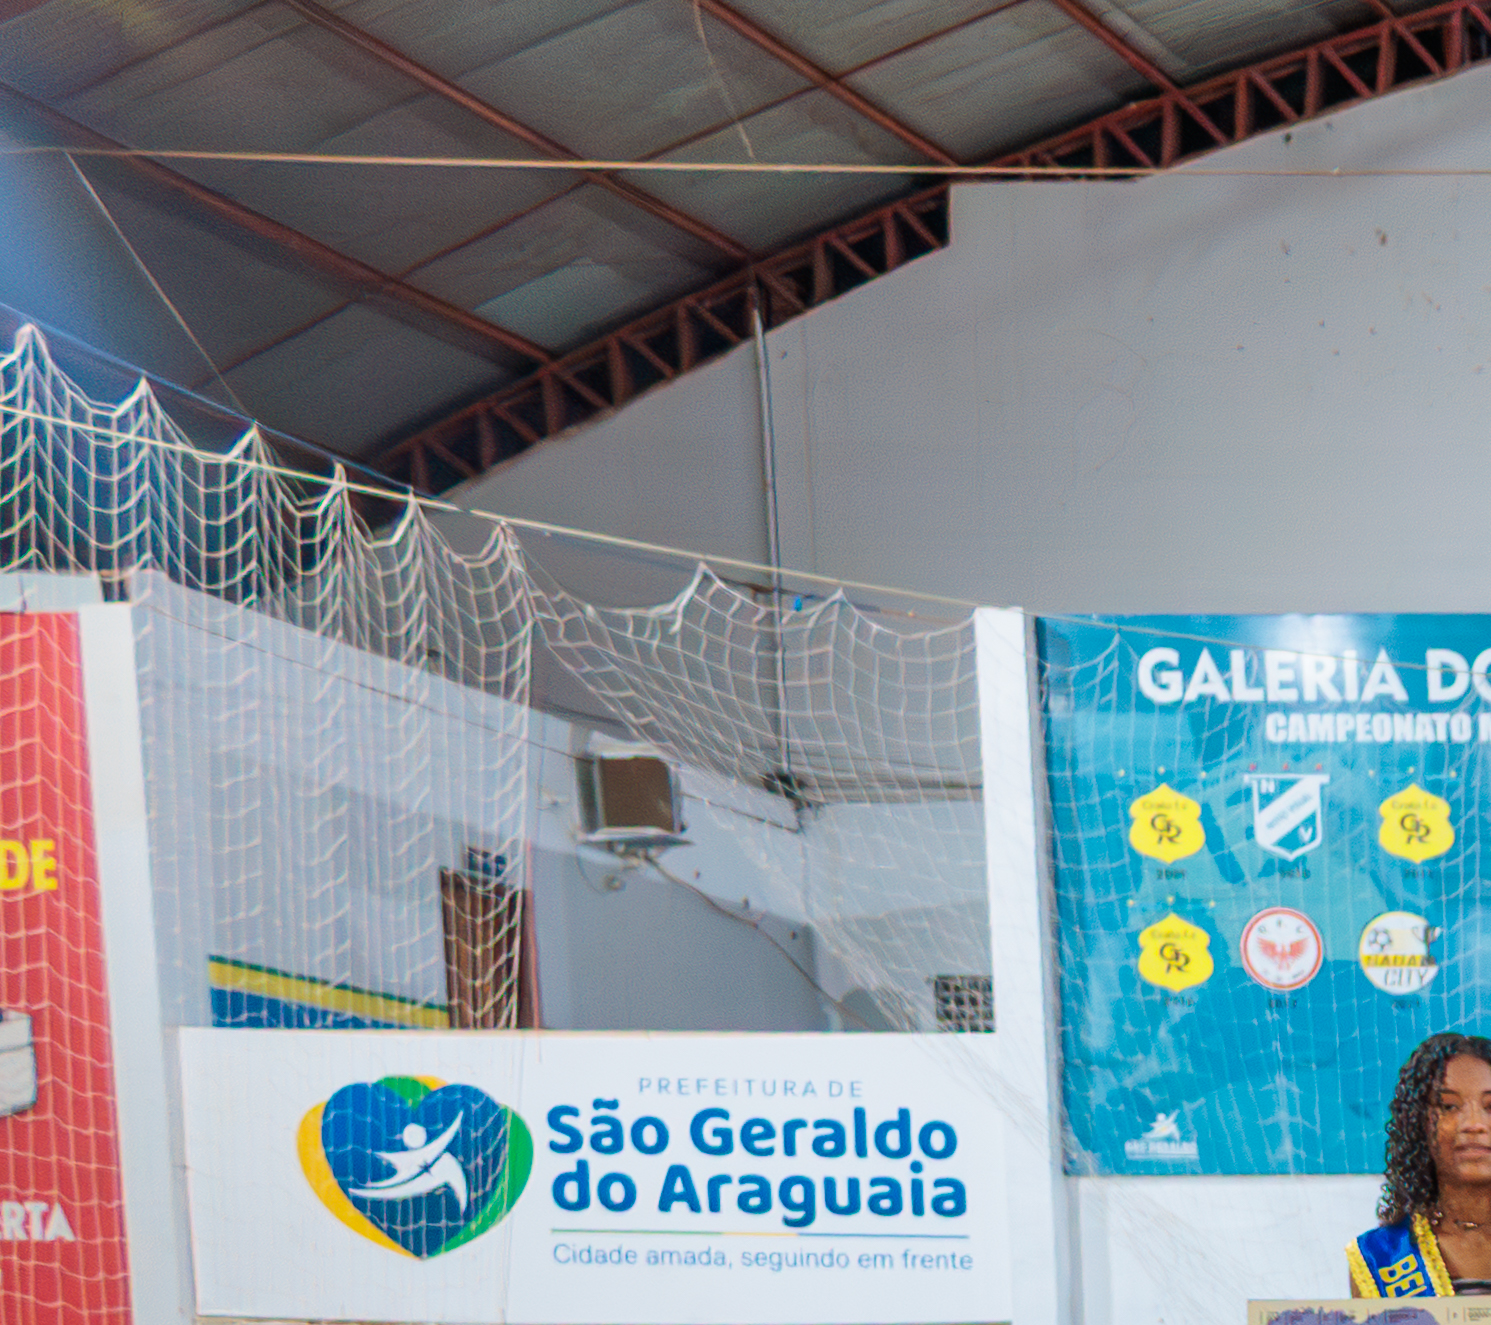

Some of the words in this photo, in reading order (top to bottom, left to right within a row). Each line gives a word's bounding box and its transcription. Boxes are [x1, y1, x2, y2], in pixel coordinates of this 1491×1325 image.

[1137, 646, 1410, 705] GALERIA
[1265, 711, 1472, 743] CAMPEONATO
[638, 1077, 818, 1098] PREFEITURA
[828, 1080, 863, 1098] DE
[547, 1098, 670, 1155] São
[689, 1106, 958, 1160] Geraldo
[552, 1159, 637, 1212] do
[658, 1160, 967, 1227] Araguaia
[0, 1201, 77, 1241] RTA
[553, 1242, 638, 1266] Cidade
[645, 1246, 734, 1269] amada,
[741, 1247, 851, 1272] seguindo
[857, 1251, 895, 1269] em
[901, 1248, 974, 1271] frente
